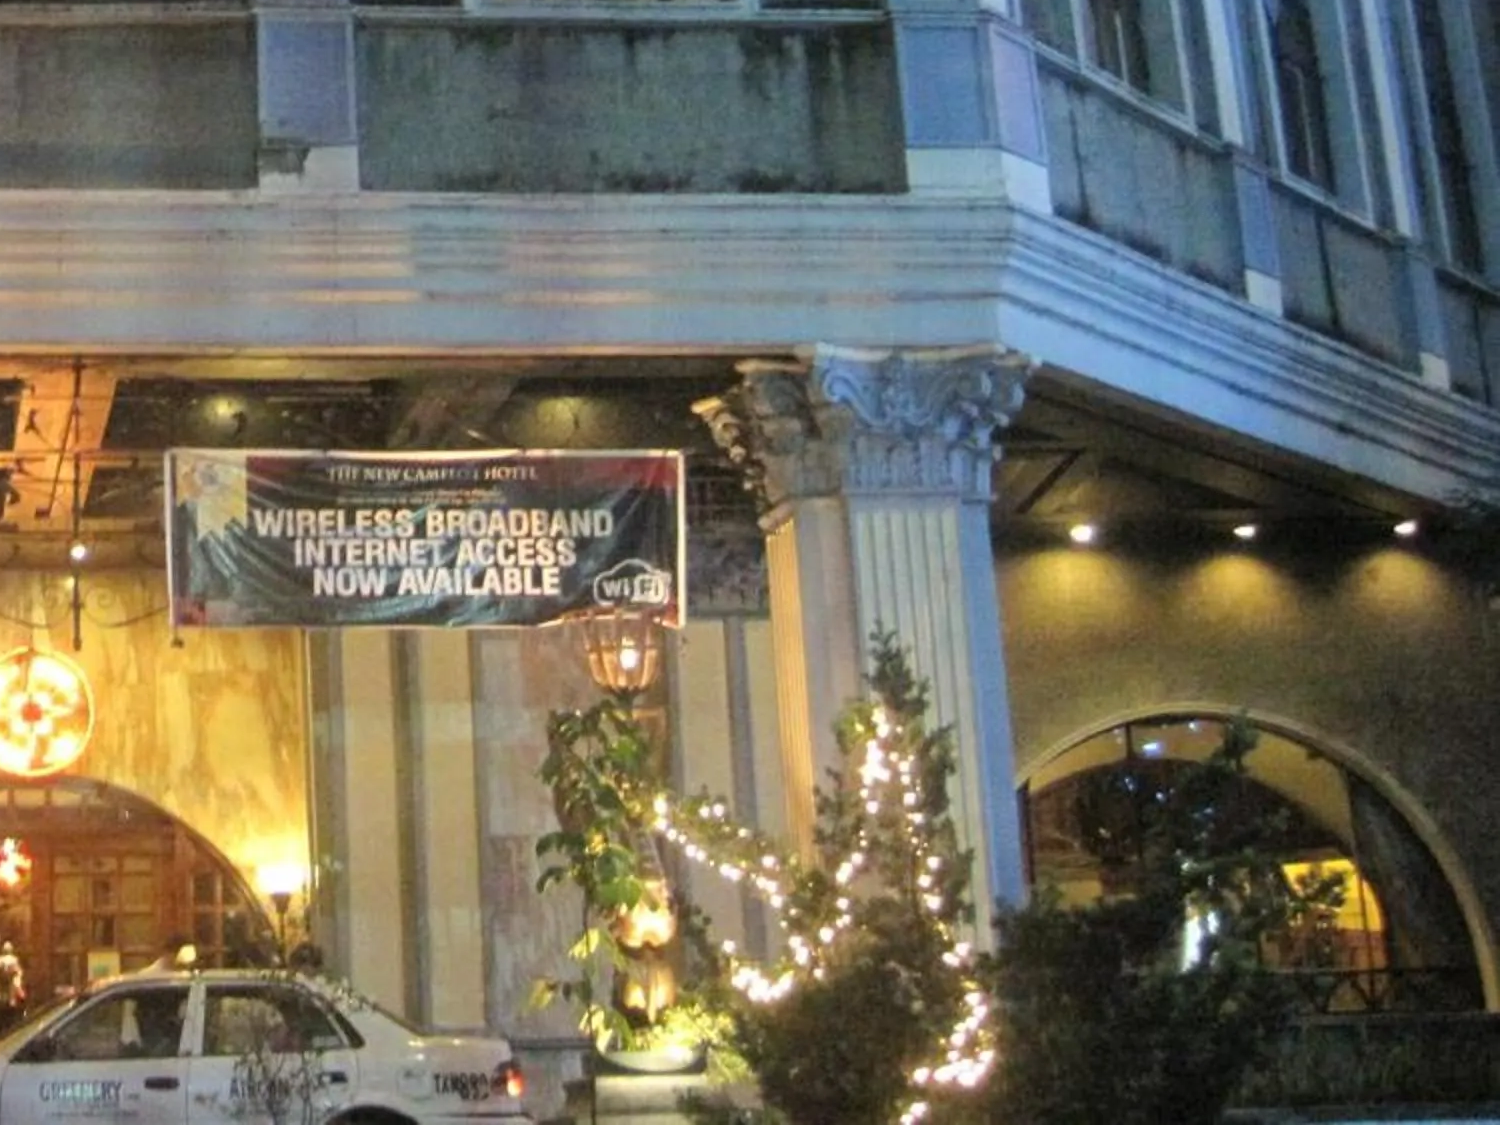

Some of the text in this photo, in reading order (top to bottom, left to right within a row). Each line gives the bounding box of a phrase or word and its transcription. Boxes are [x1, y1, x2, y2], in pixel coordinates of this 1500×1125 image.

[328, 466, 358, 481] THE
[362, 468, 400, 481] NEW
[484, 466, 538, 480] HOTEL
[253, 508, 613, 537] WIRELESS BROADBAND
[294, 537, 577, 568] INTERNET ACCESS
[313, 567, 561, 596] NOW AVAILABLE
